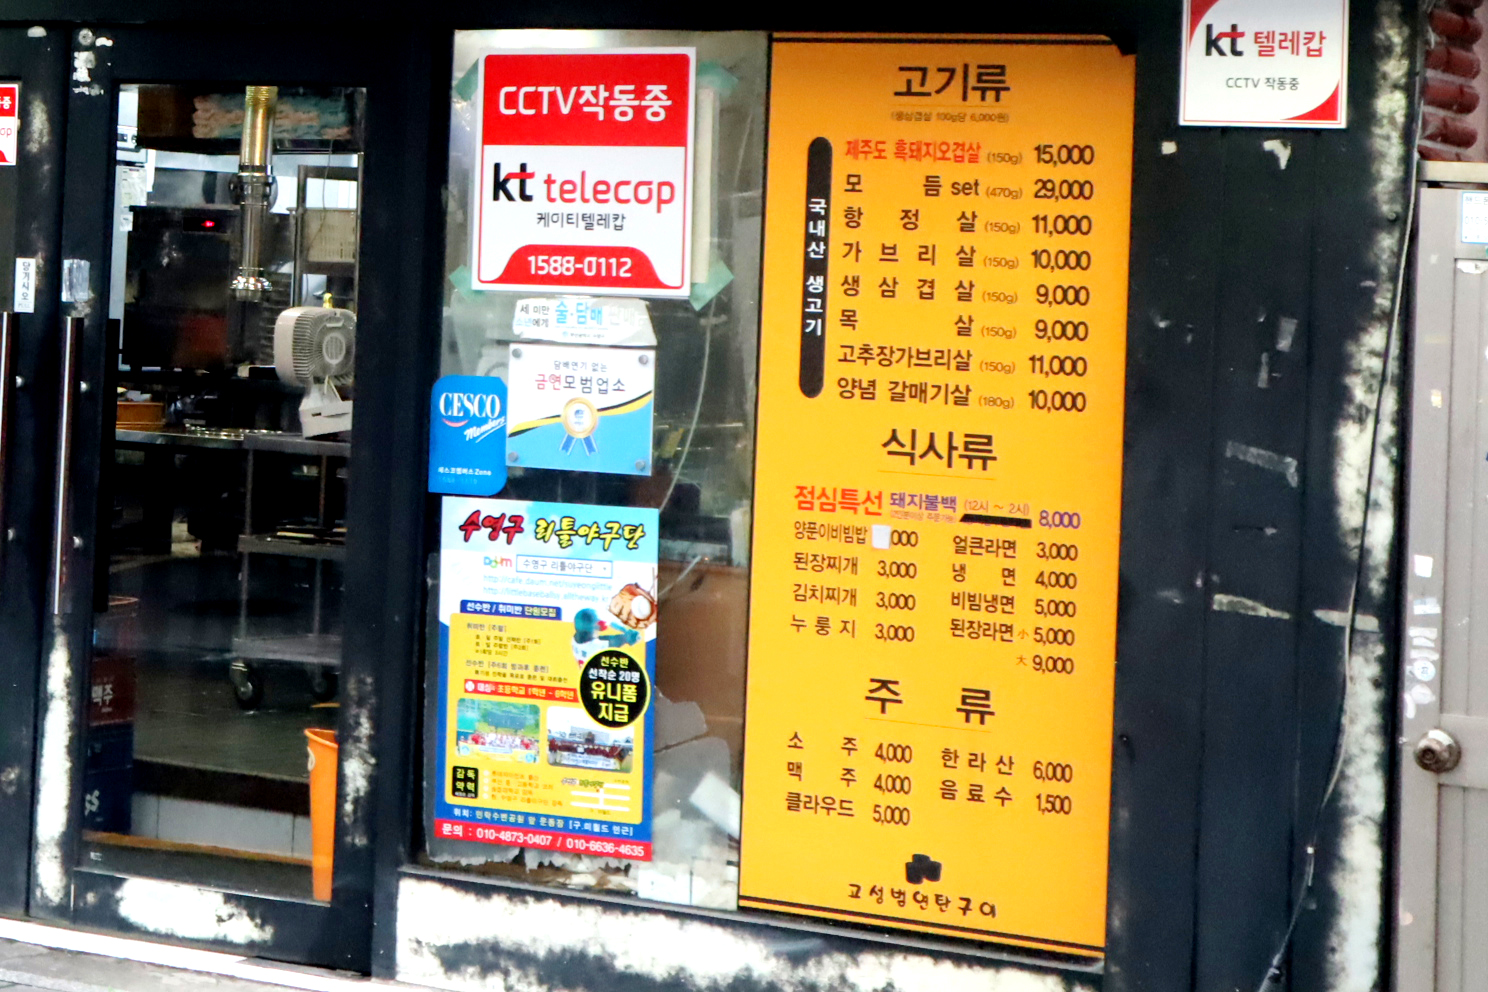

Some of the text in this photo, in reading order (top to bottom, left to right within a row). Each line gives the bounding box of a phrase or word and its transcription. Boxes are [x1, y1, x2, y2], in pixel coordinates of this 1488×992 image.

[1205, 23, 1327, 58] kt 텔레캅
[893, 63, 1011, 103] 고기류
[1224, 76, 1300, 91] CCTV 작동중
[498, 84, 673, 122] CCTV작동중
[845, 138, 1095, 166] 제주도 흑돼지오겹살 (150g) 15,000
[492, 162, 676, 214] kt telecop
[950, 178, 980, 197] set
[985, 185, 1023, 200] (470g)
[1033, 178, 1094, 201] 29,000
[536, 211, 627, 231] 케이티텔레캅
[983, 220, 1021, 235] (150g)
[1031, 214, 1093, 236] 11,000
[527, 254, 633, 278] 1588-0112
[804, 198, 828, 337] 국내산 생고기
[982, 255, 1020, 270] (150g)
[1030, 249, 1092, 273] 10,000
[20, 261, 32, 301] 당기시오
[981, 290, 1019, 305] (150g)
[1035, 283, 1091, 307] 9,000
[532, 305, 550, 316] 미만
[980, 318, 1090, 343] (150g) 9,000
[553, 360, 608, 373] 담배연기 없는
[837, 344, 1088, 378] 고추장가브리살 (150g) 11,000
[534, 373, 626, 395] 금연모범업소
[836, 377, 1088, 413] 양념 갈매기살 (180g) 10,000
[439, 392, 501, 419] CESCO
[463, 415, 506, 442] Members
[881, 428, 998, 472] 식사류
[793, 485, 884, 516] 점심특선
[889, 491, 958, 513] 돼지불백
[1038, 509, 1082, 530] 8,000
[459, 509, 646, 552] 수영구 리틀야구단
[793, 520, 869, 545] 양푼이비빔밥
[951, 534, 1079, 562] 얼큰라면 3,000
[523, 558, 548, 570] 수영구
[550, 560, 594, 574] 리틀야구단
[792, 551, 918, 581] 된장찌개 3,000
[1034, 570, 1078, 591] 4,000
[791, 582, 917, 612] 김치찌개 3,000
[950, 590, 1077, 619] 비빔냉면 5,000
[874, 622, 916, 644] 3,000
[949, 617, 1014, 643] 된장라면
[1032, 626, 1076, 647] 5,000
[600, 656, 629, 668] 선수반
[1031, 653, 1075, 675] 9,000
[587, 668, 641, 683] 선착순 20명
[590, 682, 639, 703] 유니폼
[598, 702, 630, 723] 지급
[874, 742, 913, 764] 4,000
[873, 773, 912, 796] 4,000
[1032, 760, 1074, 784] 6,000
[784, 791, 911, 826] 클라우드 5,000
[1035, 794, 1073, 816] 1,500
[442, 822, 645, 857] 문의 010-4873-0407 010-6636-4635
